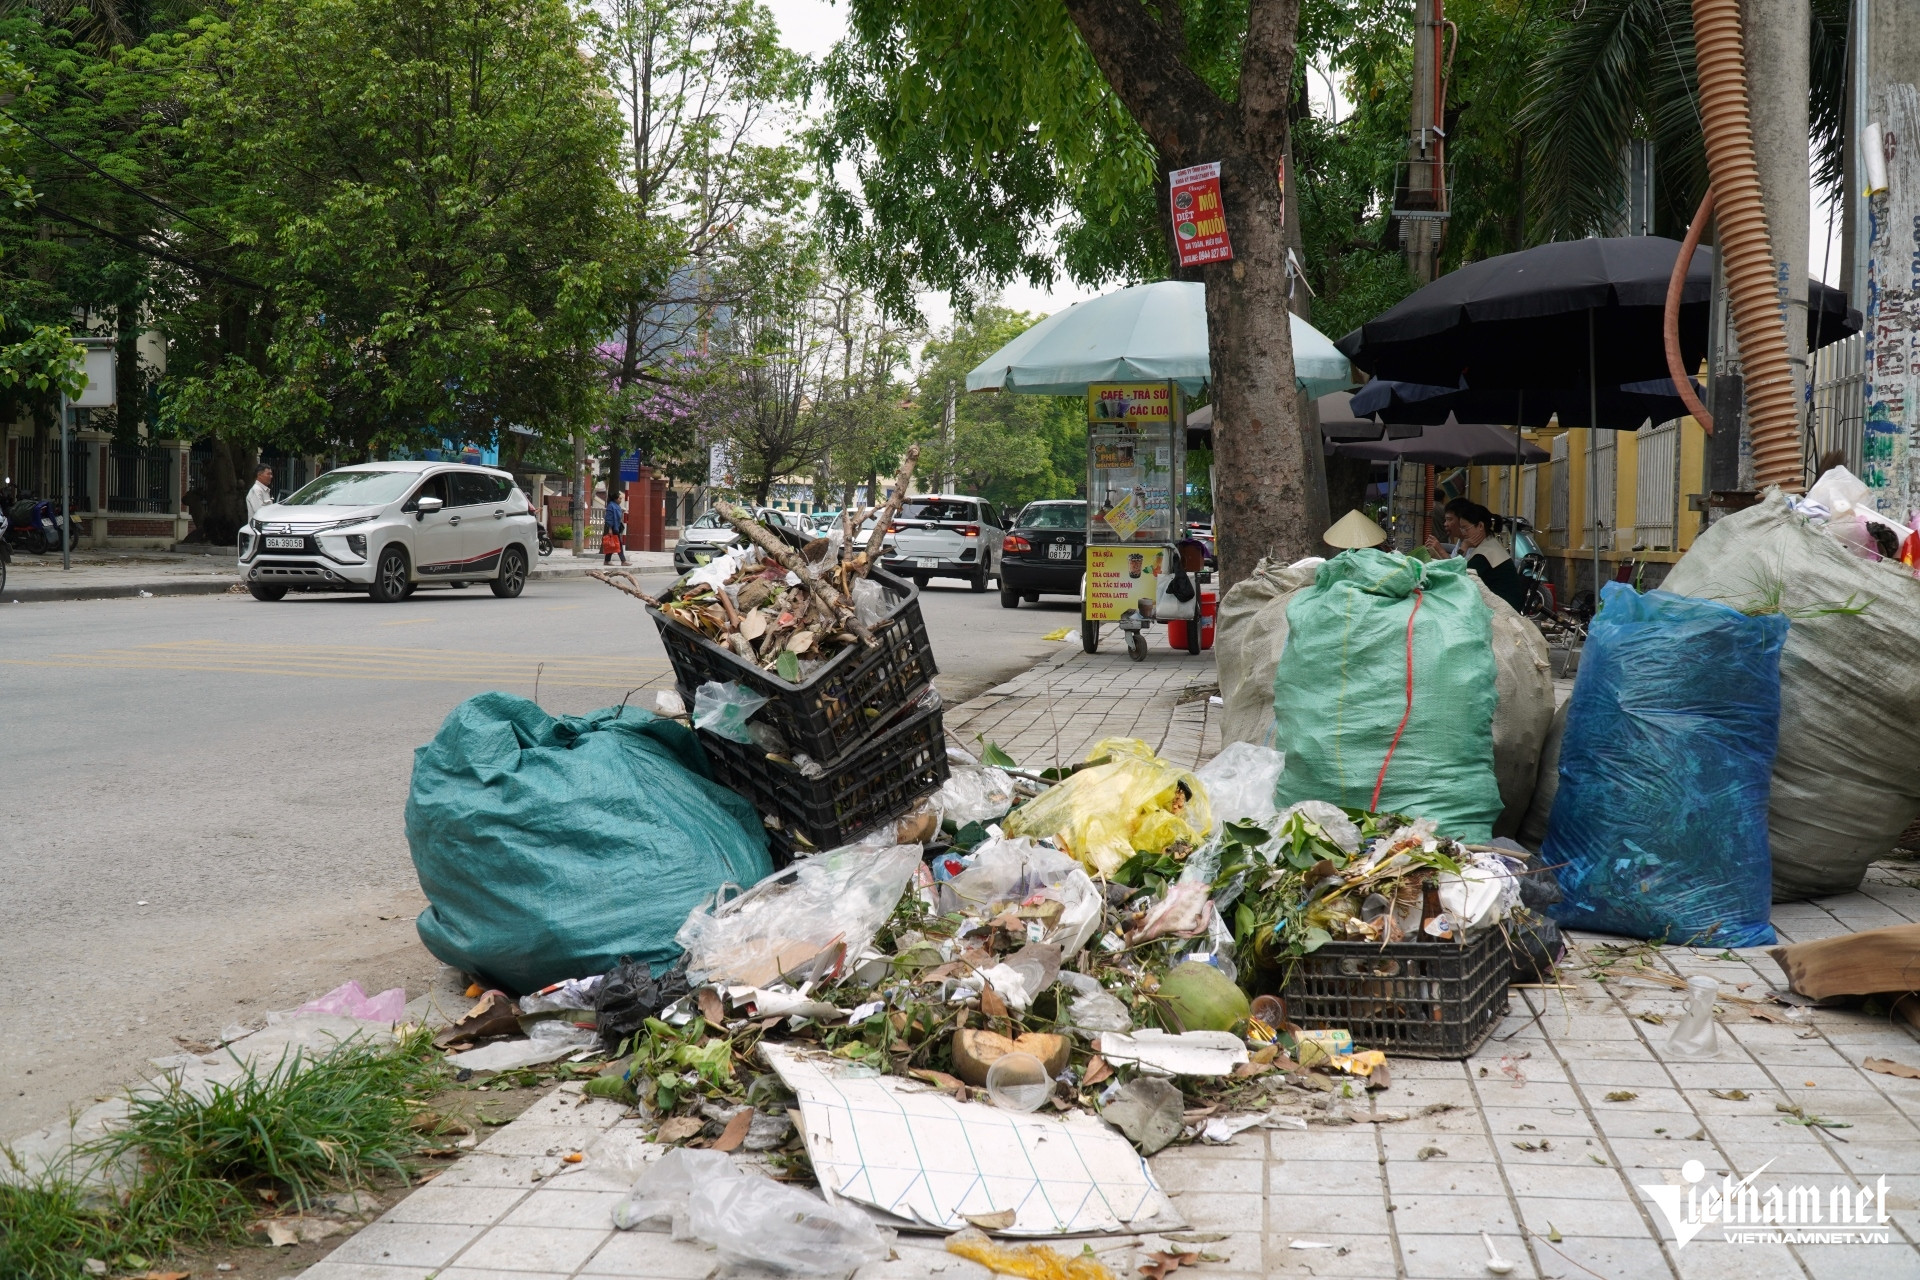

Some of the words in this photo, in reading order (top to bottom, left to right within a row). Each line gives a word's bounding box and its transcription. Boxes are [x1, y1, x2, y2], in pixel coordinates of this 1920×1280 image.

[1198, 187, 1218, 212] MỐI
[1176, 210, 1194, 222] DIỆT
[1197, 212, 1226, 238] MUỖI
[1133, 388, 1150, 400] TRÀ
[1130, 404, 1148, 415] CÁC
[1152, 406, 1168, 417] LOẠ
